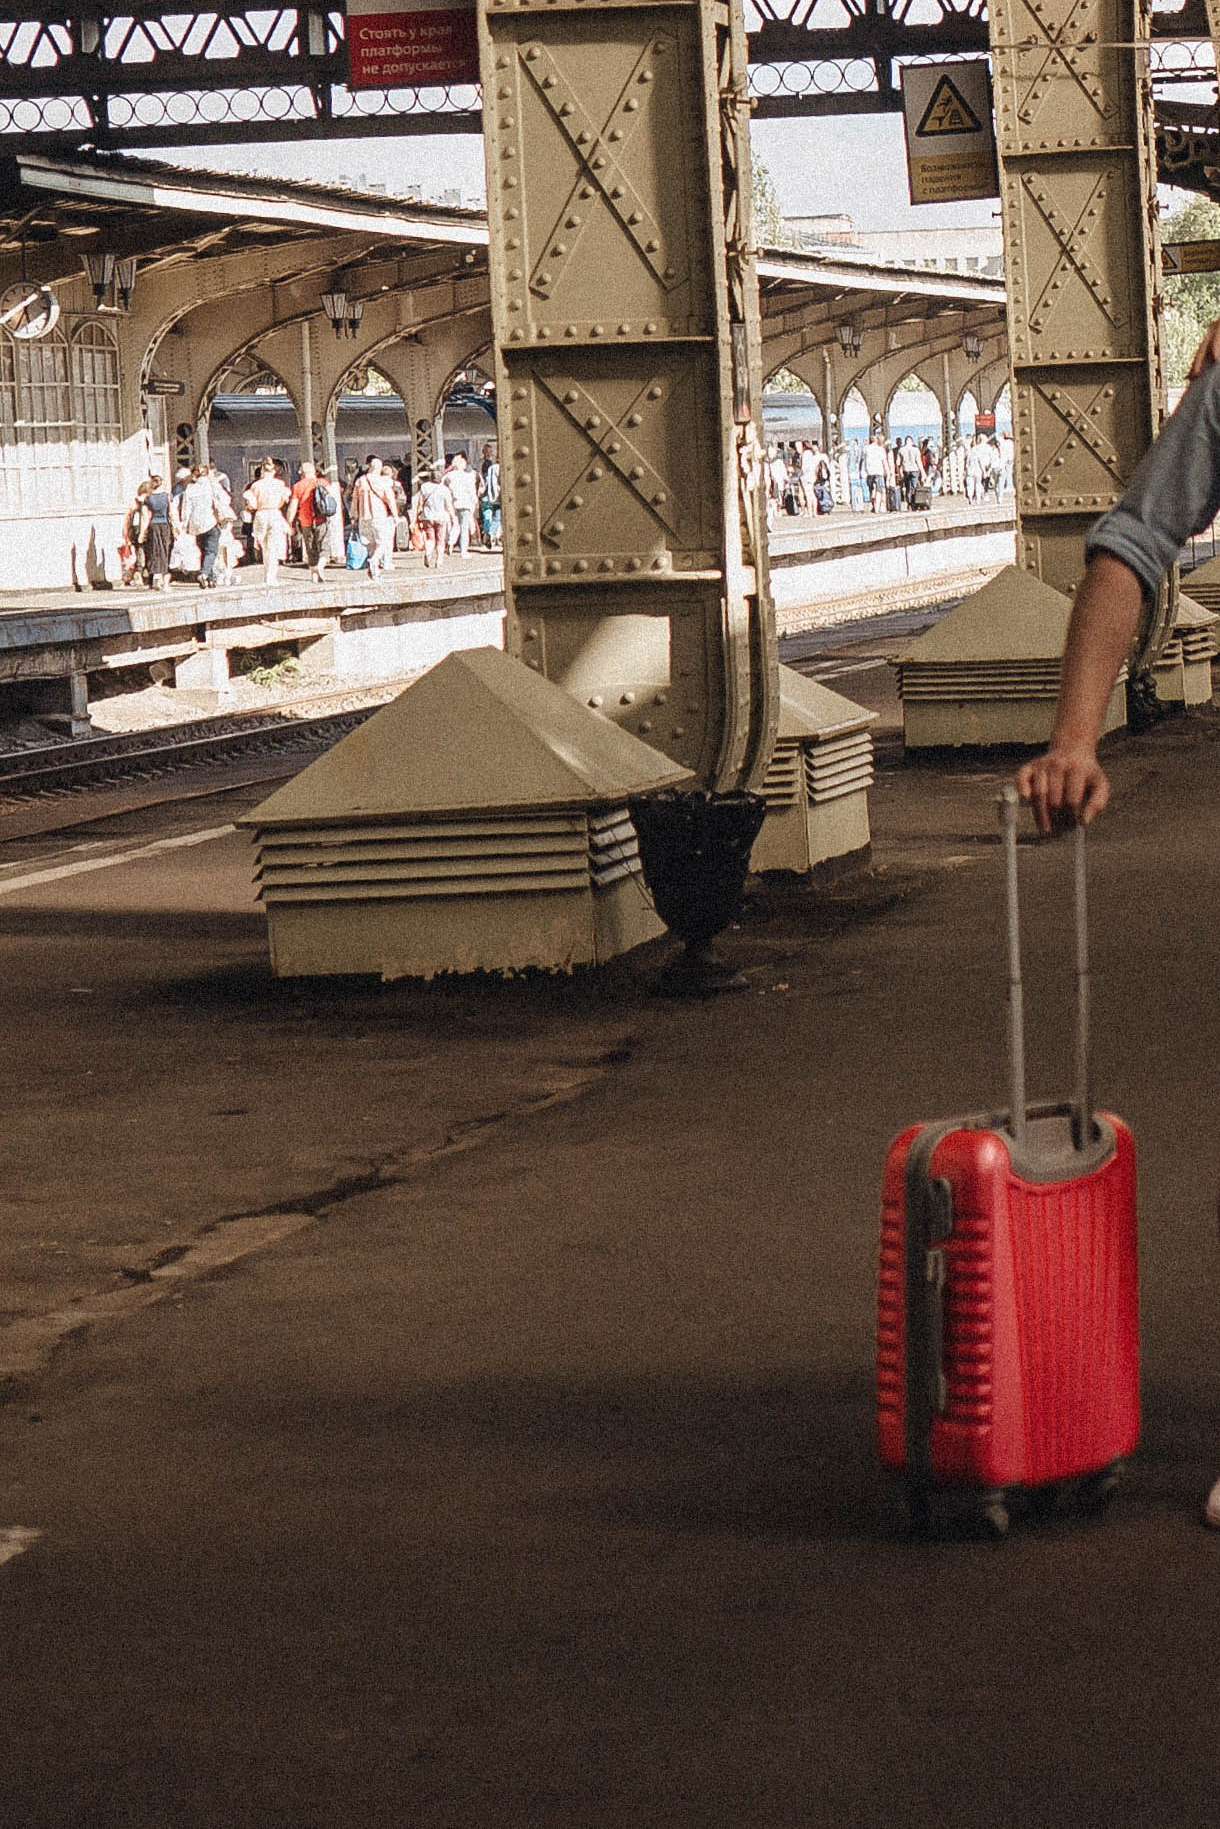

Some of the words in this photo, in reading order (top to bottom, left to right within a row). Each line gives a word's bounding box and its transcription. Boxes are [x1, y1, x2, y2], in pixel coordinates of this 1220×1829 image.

[359, 27, 407, 40] Стоять
[409, 28, 417, 41] у
[360, 44, 443, 58] платформы
[362, 64, 379, 74] не
